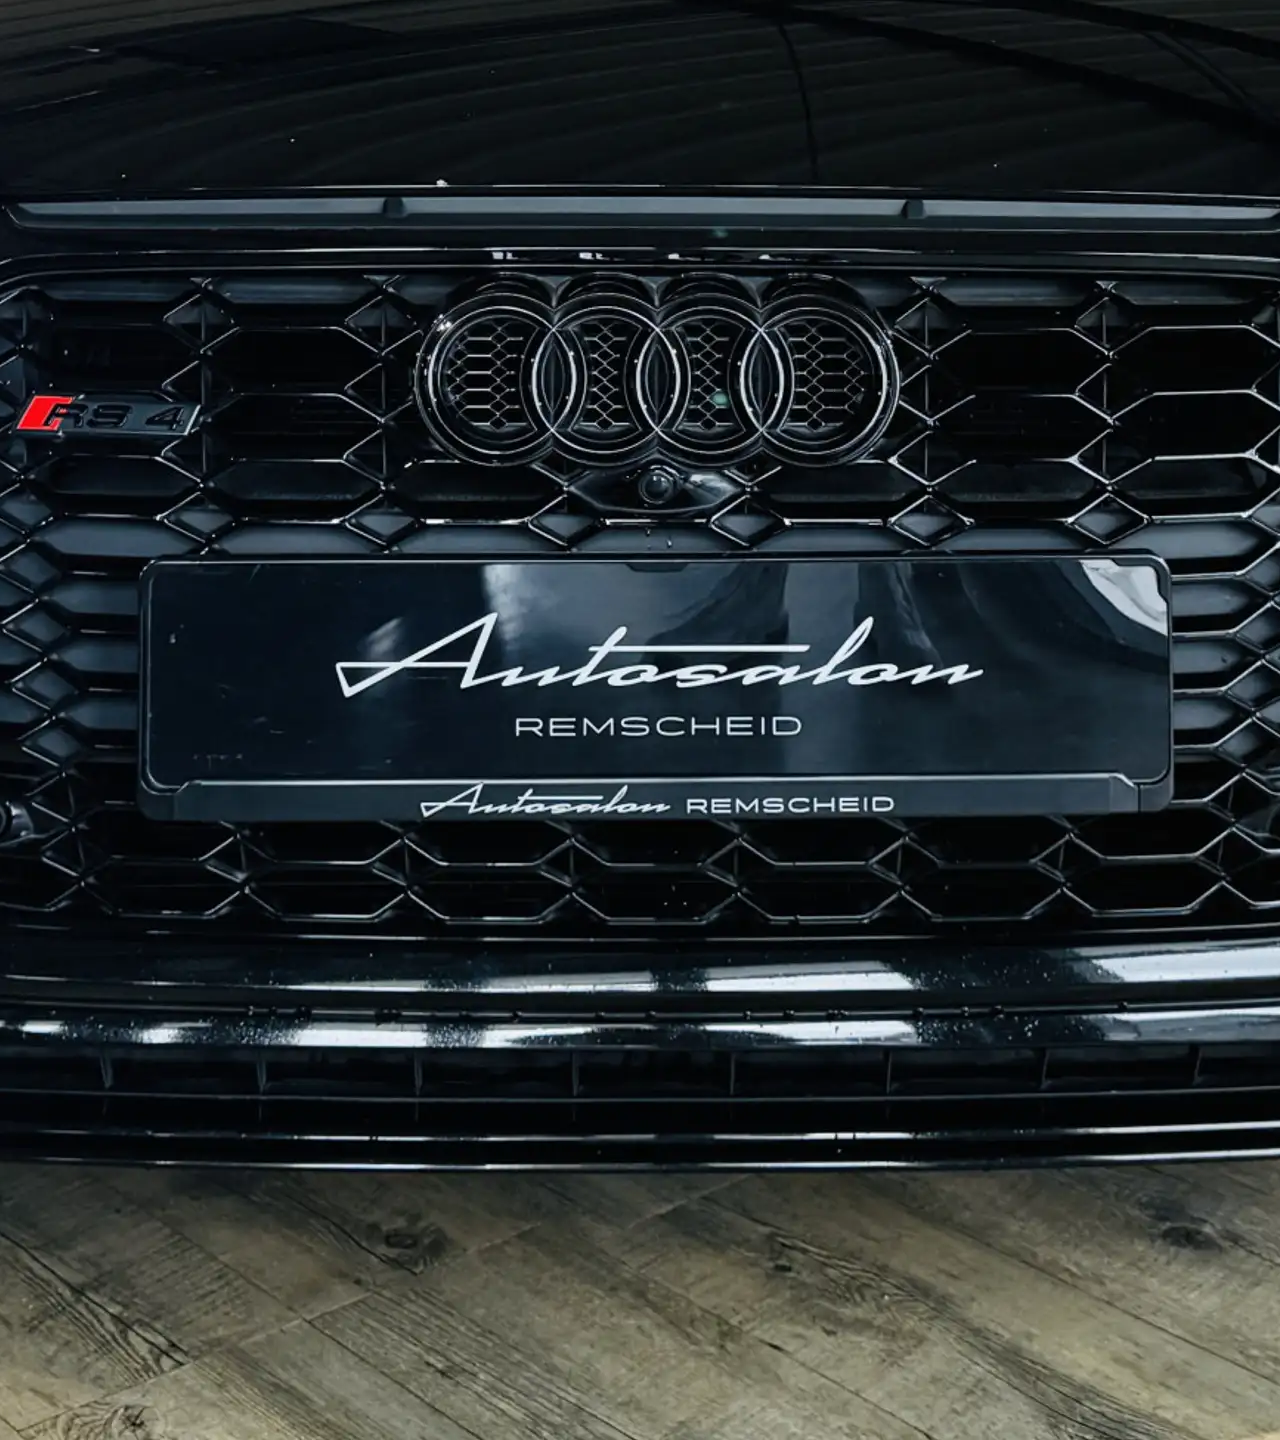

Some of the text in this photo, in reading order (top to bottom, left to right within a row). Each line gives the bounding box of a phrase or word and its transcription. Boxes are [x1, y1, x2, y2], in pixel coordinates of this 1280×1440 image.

[144, 405, 184, 430] 4
[335, 611, 984, 698] Autosalon
[515, 715, 803, 738] REMSCHEID
[420, 781, 895, 818] Autosalon REMSCHEID
